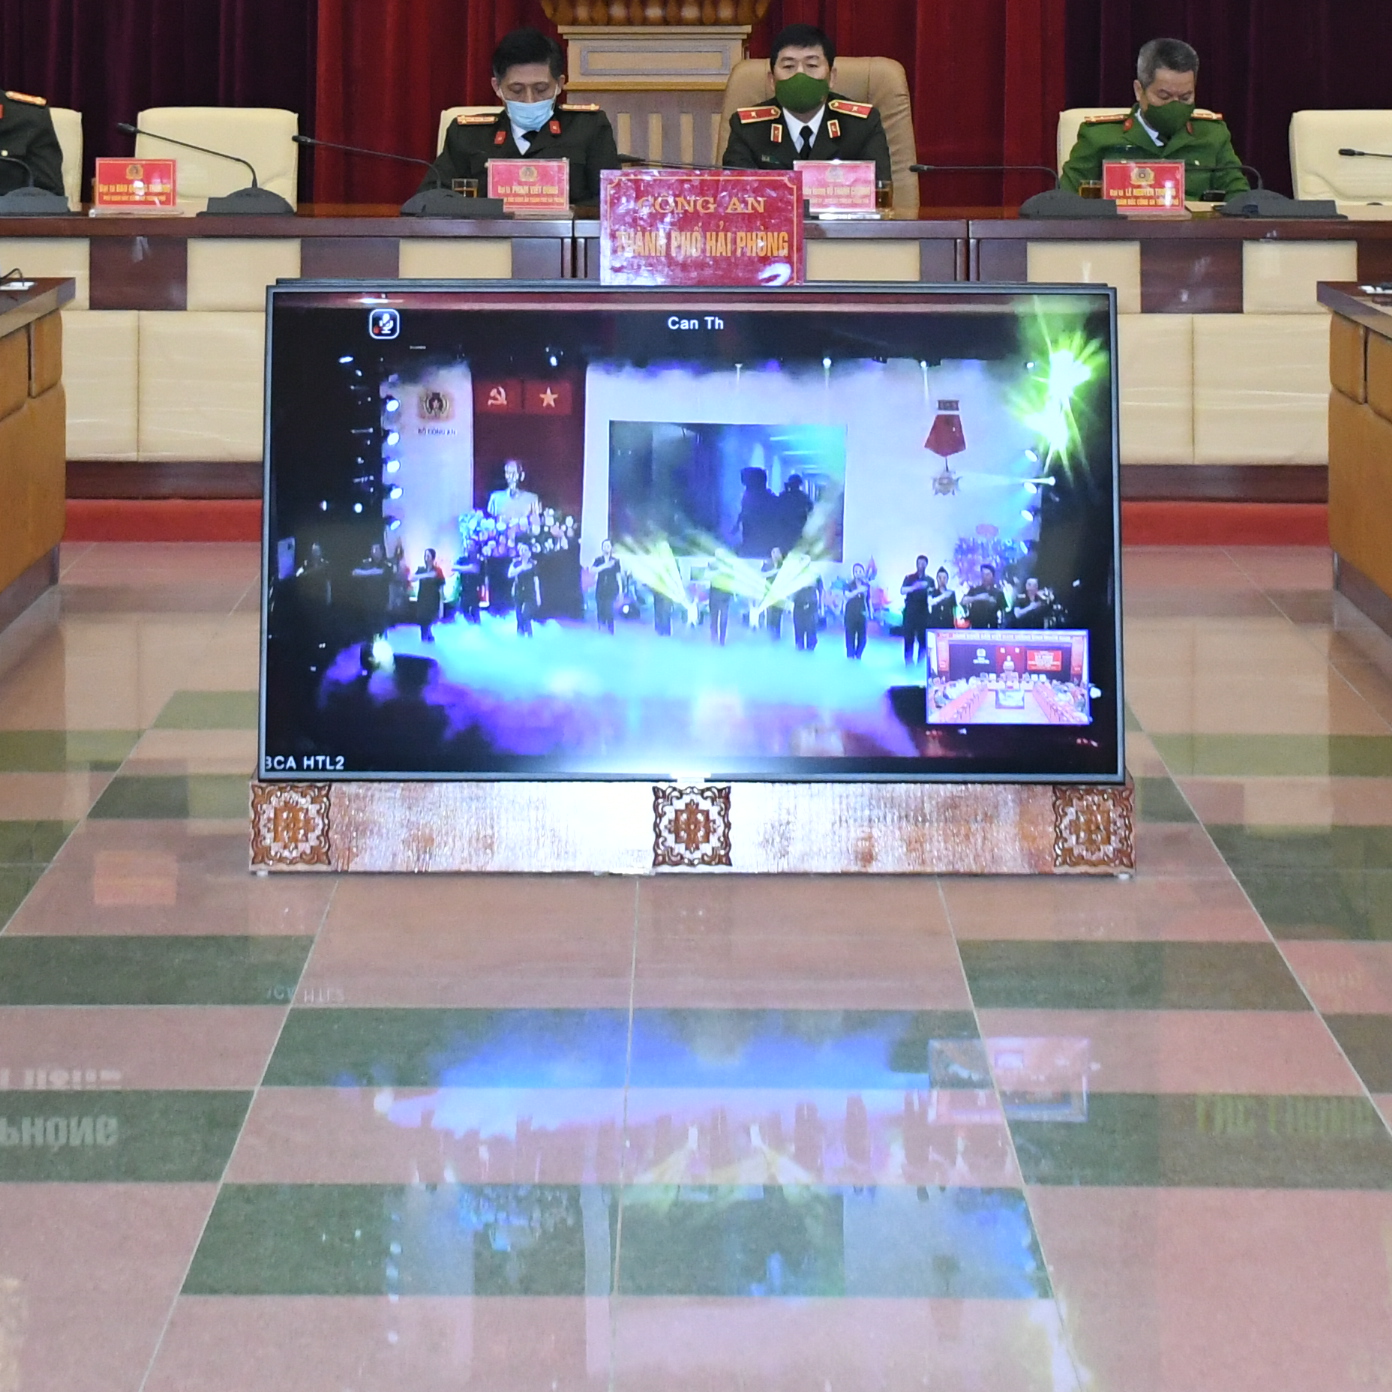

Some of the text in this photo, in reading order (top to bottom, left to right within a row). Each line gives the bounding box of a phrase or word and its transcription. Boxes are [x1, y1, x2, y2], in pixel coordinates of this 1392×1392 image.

[637, 193, 767, 214] CÔNG AN
[617, 220, 789, 257] THÀNH PHỐ HẢI PHÒNG
[667, 316, 725, 330] Can Th
[303, 755, 345, 770] HTL2
